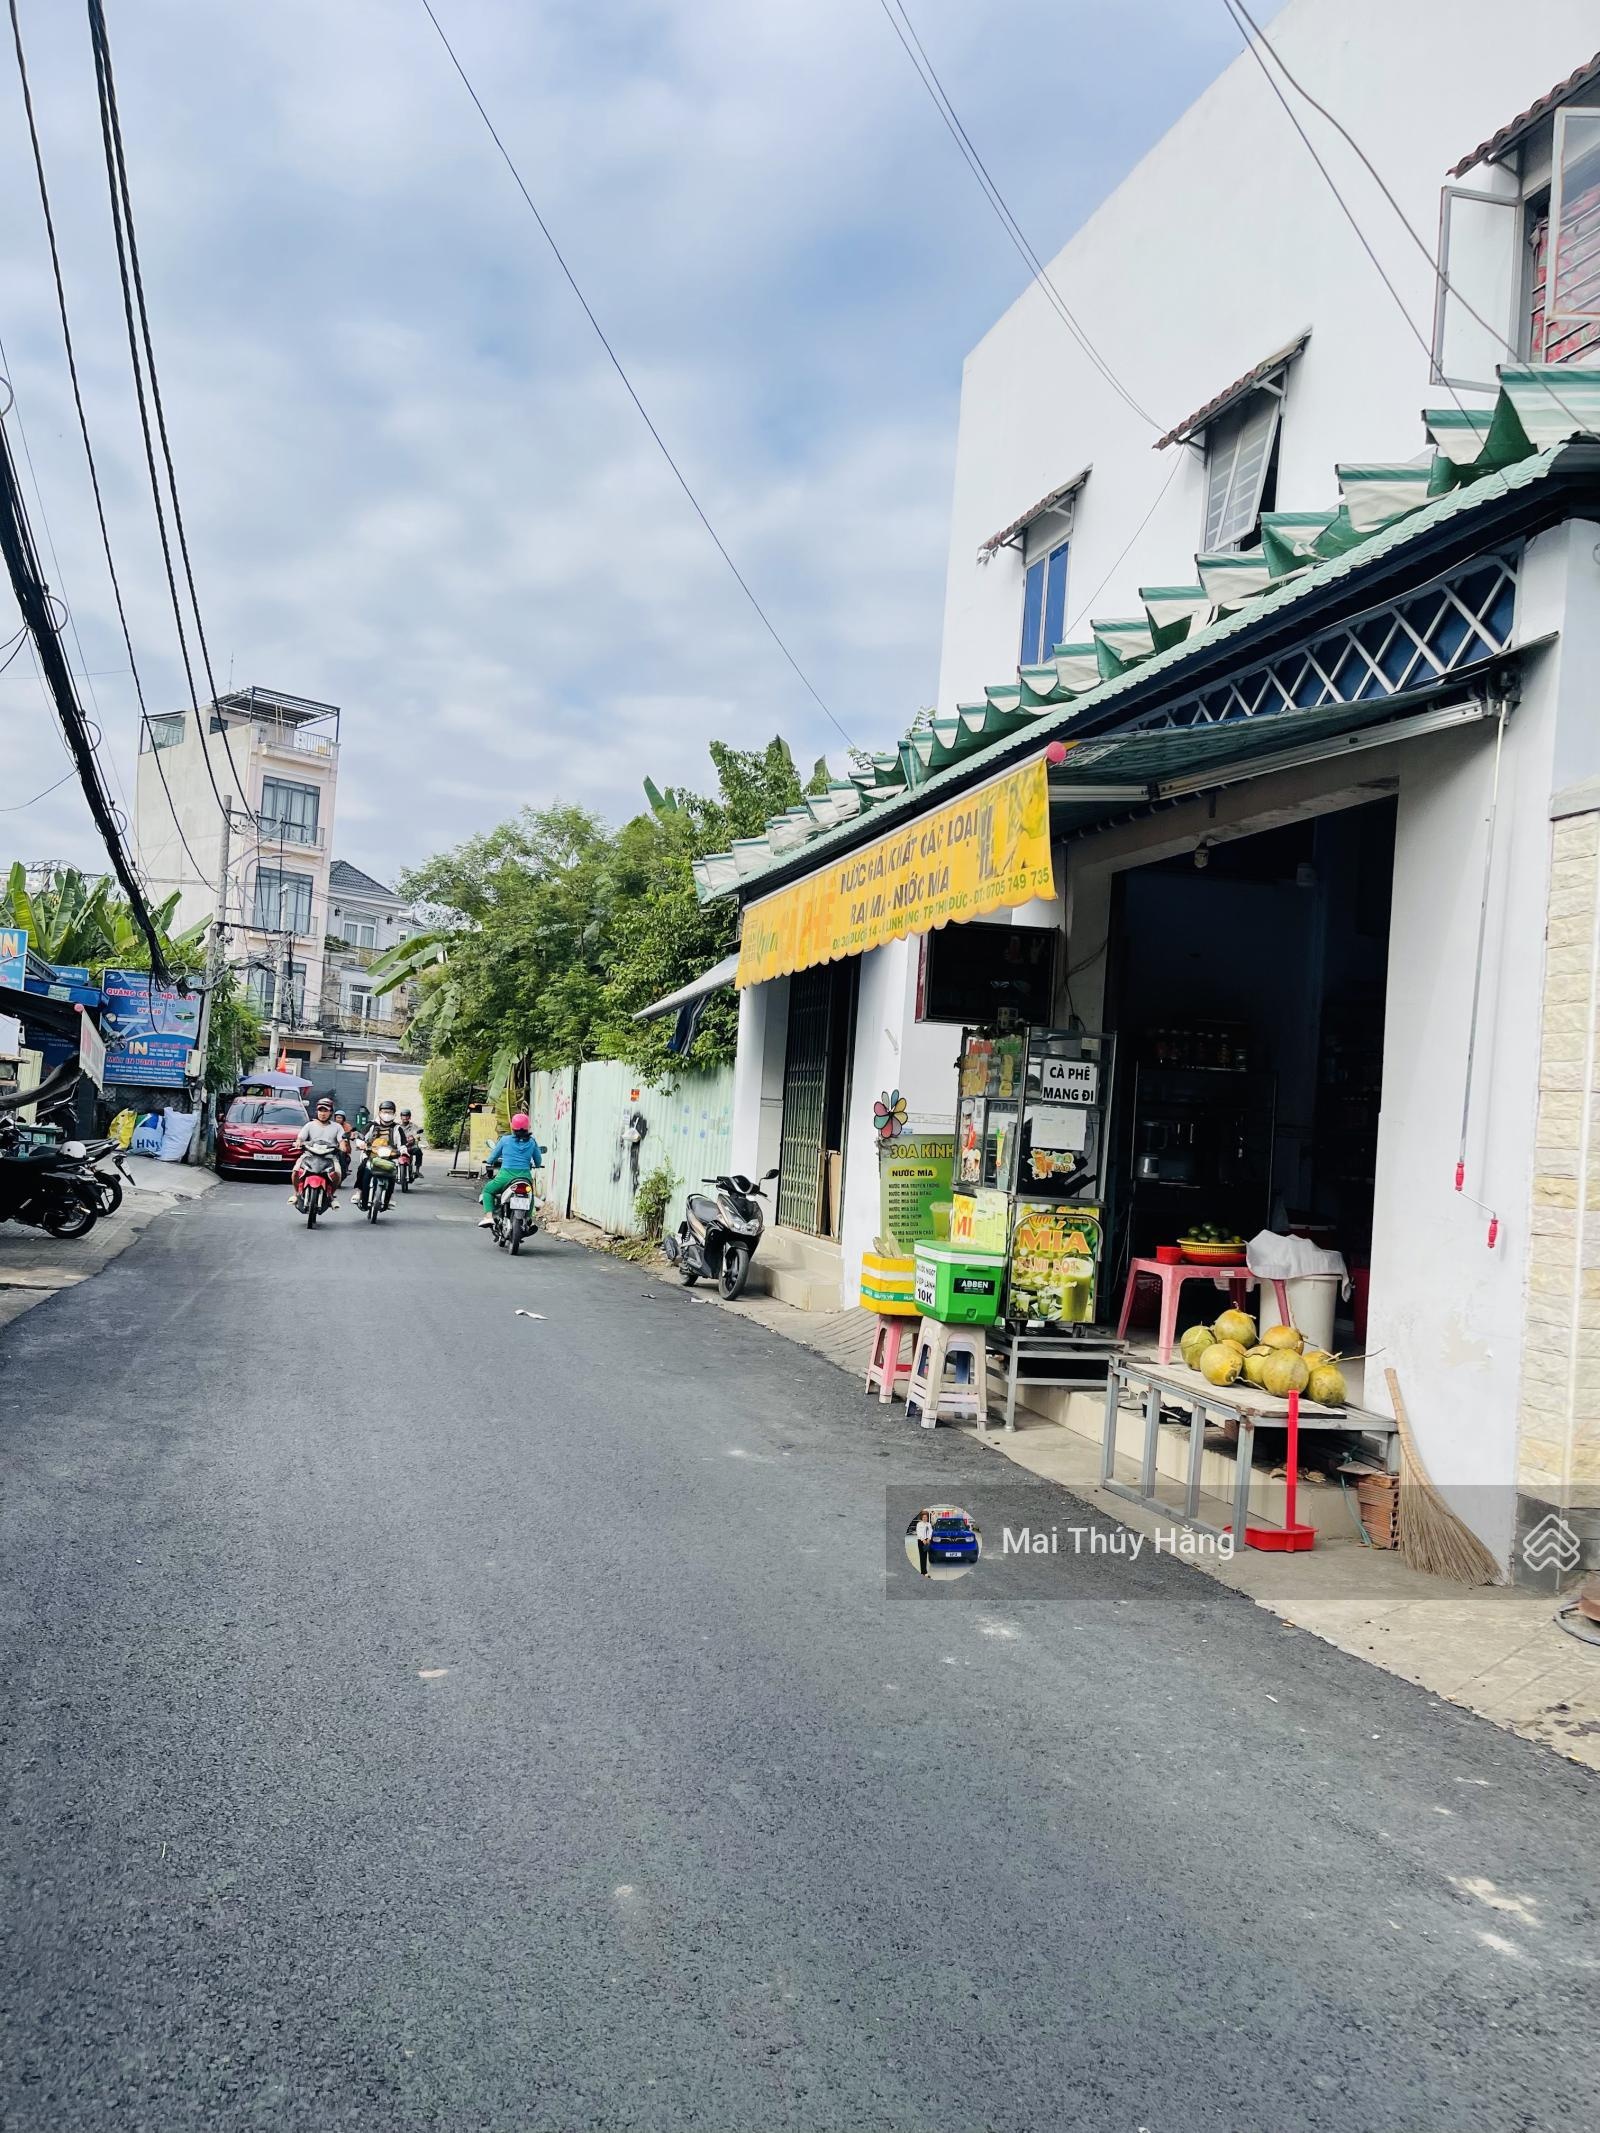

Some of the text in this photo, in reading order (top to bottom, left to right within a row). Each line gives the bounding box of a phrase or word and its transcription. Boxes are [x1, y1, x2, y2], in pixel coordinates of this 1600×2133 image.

[920, 821, 944, 858] CÁC
[947, 808, 979, 848] LOẠI
[949, 890, 968, 910] ĐỨC
[986, 879, 1006, 898] 0705
[1007, 873, 1027, 892] 749
[1030, 866, 1050, 887] 735
[128, 1041, 148, 1055] IN
[1049, 1064, 1091, 1081] CÀ PHÊ
[1043, 1086, 1094, 1102] MANG ĐI
[890, 1143, 919, 1159] 30A
[892, 1168, 915, 1177] NƯỚC
[1018, 1220, 1093, 1255] MÍA
[917, 1288, 933, 1304] 10K
